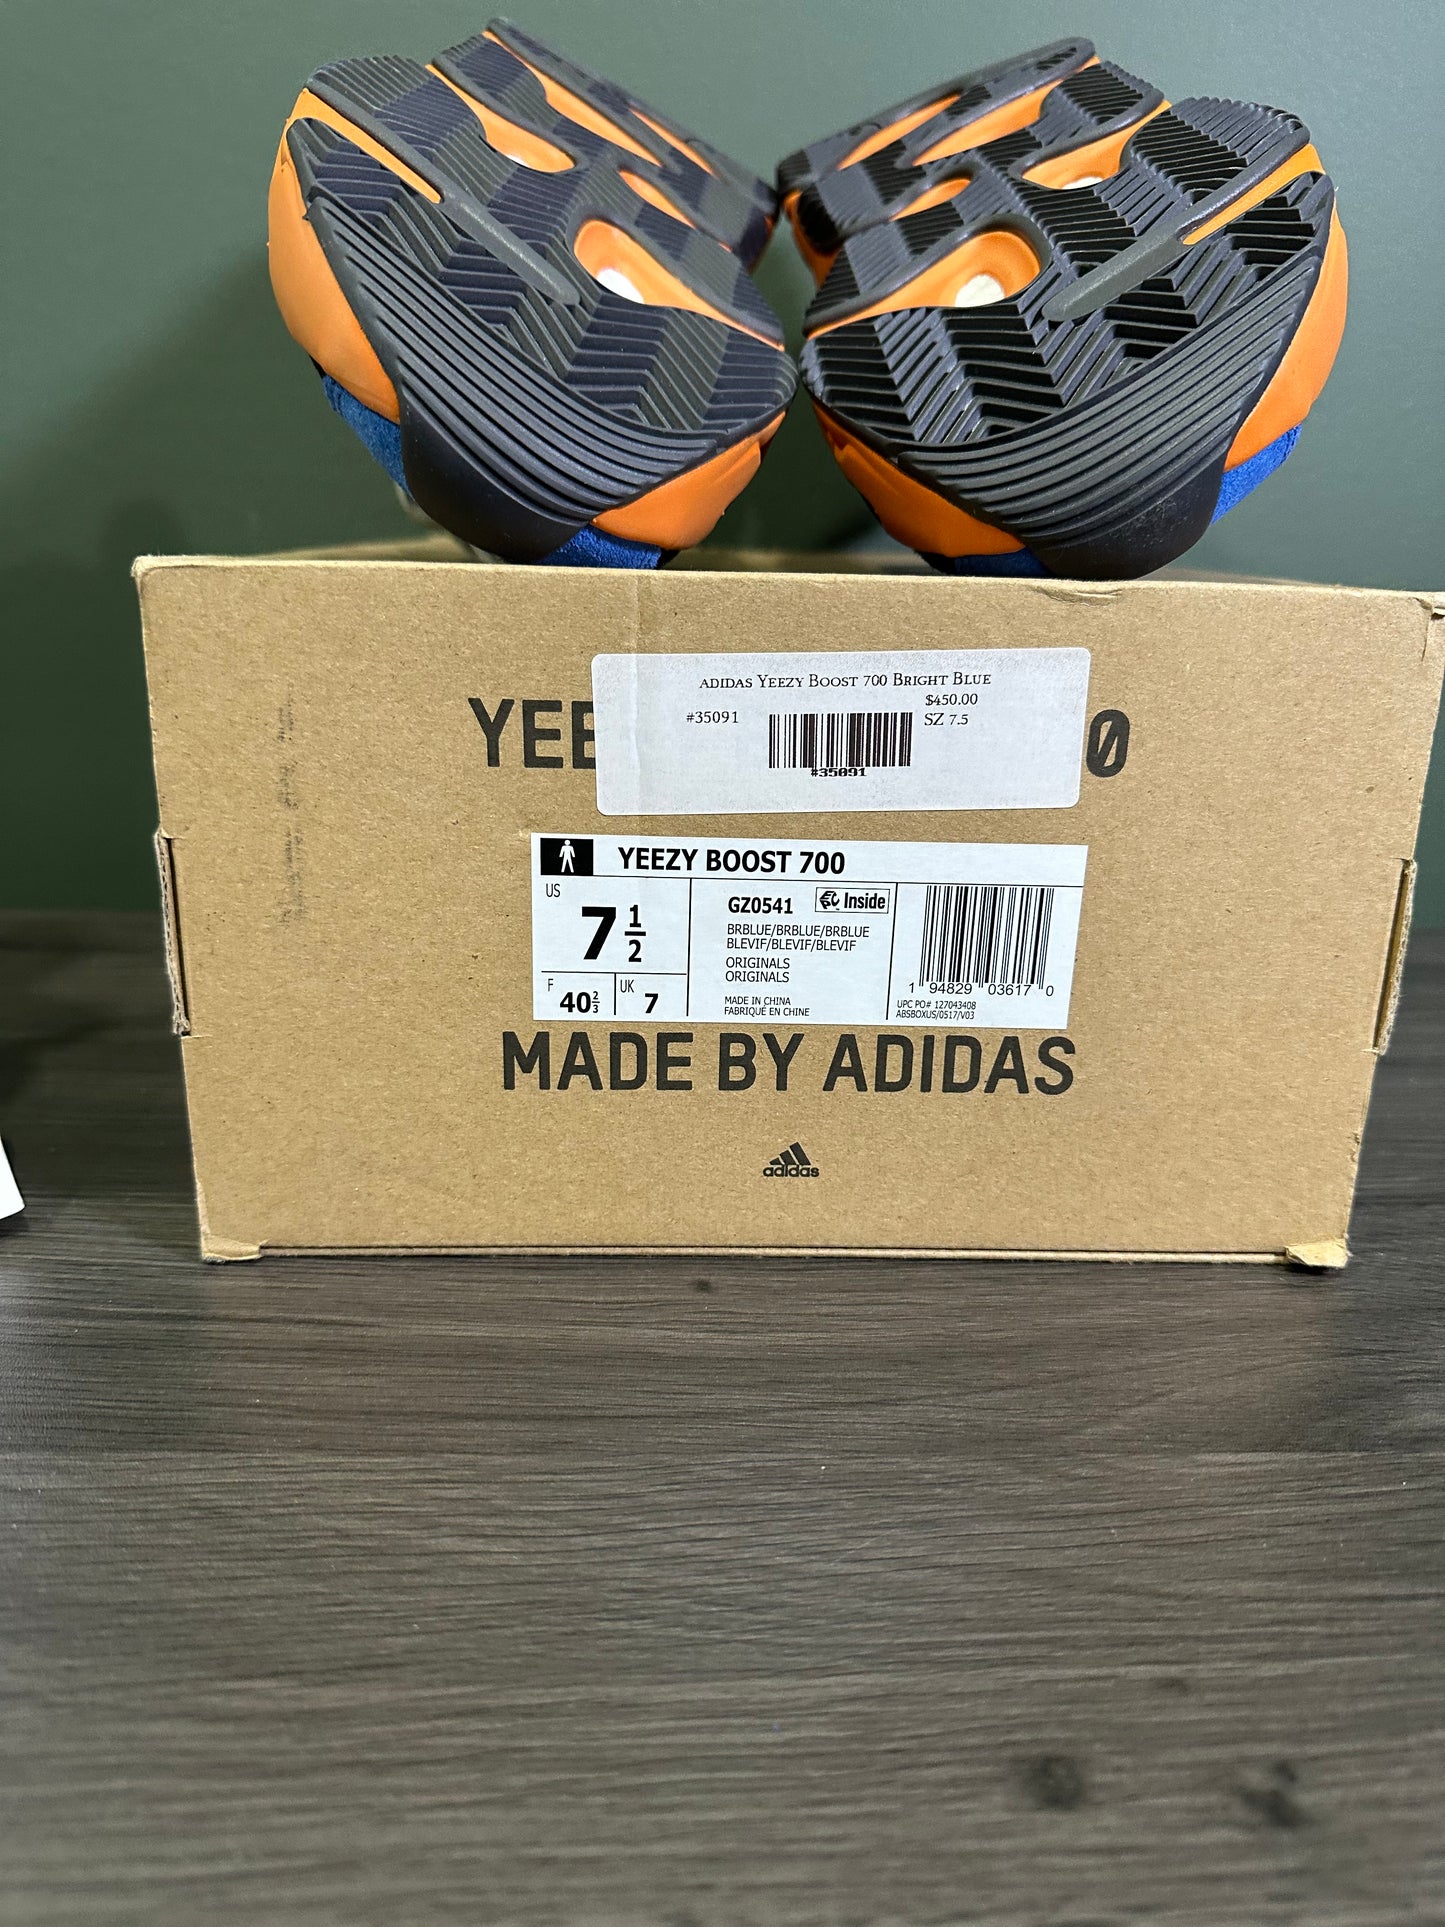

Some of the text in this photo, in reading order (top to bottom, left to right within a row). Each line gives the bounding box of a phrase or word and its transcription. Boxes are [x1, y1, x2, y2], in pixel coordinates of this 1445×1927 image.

[864, 674, 887, 687] 700
[925, 693, 978, 706] $450.00
[686, 709, 740, 725] #35091
[924, 713, 969, 726] SZ 7.5
[810, 767, 867, 777] #35091
[617, 846, 845, 874] YEEZY BOOST 700
[545, 883, 561, 898] US
[727, 896, 794, 915] GZ0541
[843, 892, 886, 911] Inside
[581, 905, 617, 961] 7
[727, 923, 870, 938] BRBLUE/BRBLUE/BRBLUE
[726, 937, 857, 952] BLEVIF/BLEVIF/BLEVIF
[725, 957, 791, 969] ORIGINALS
[725, 970, 790, 983] ORIGINALS
[547, 978, 554, 992] F
[620, 979, 635, 993] UK
[908, 982, 1055, 997] 1 94829 03617 0
[644, 992, 659, 1014] 7
[724, 995, 791, 1006] MADE IN CHINA
[896, 999, 977, 1010] UPC PO# 127043408
[768, 1007, 781, 1016] EN
[783, 1007, 810, 1017] CHINE
[895, 1009, 975, 1021] ABSBOXUS/0517/V03
[503, 1031, 1076, 1096] MADE BY ADIDAS
[762, 1163, 819, 1178] adidas
